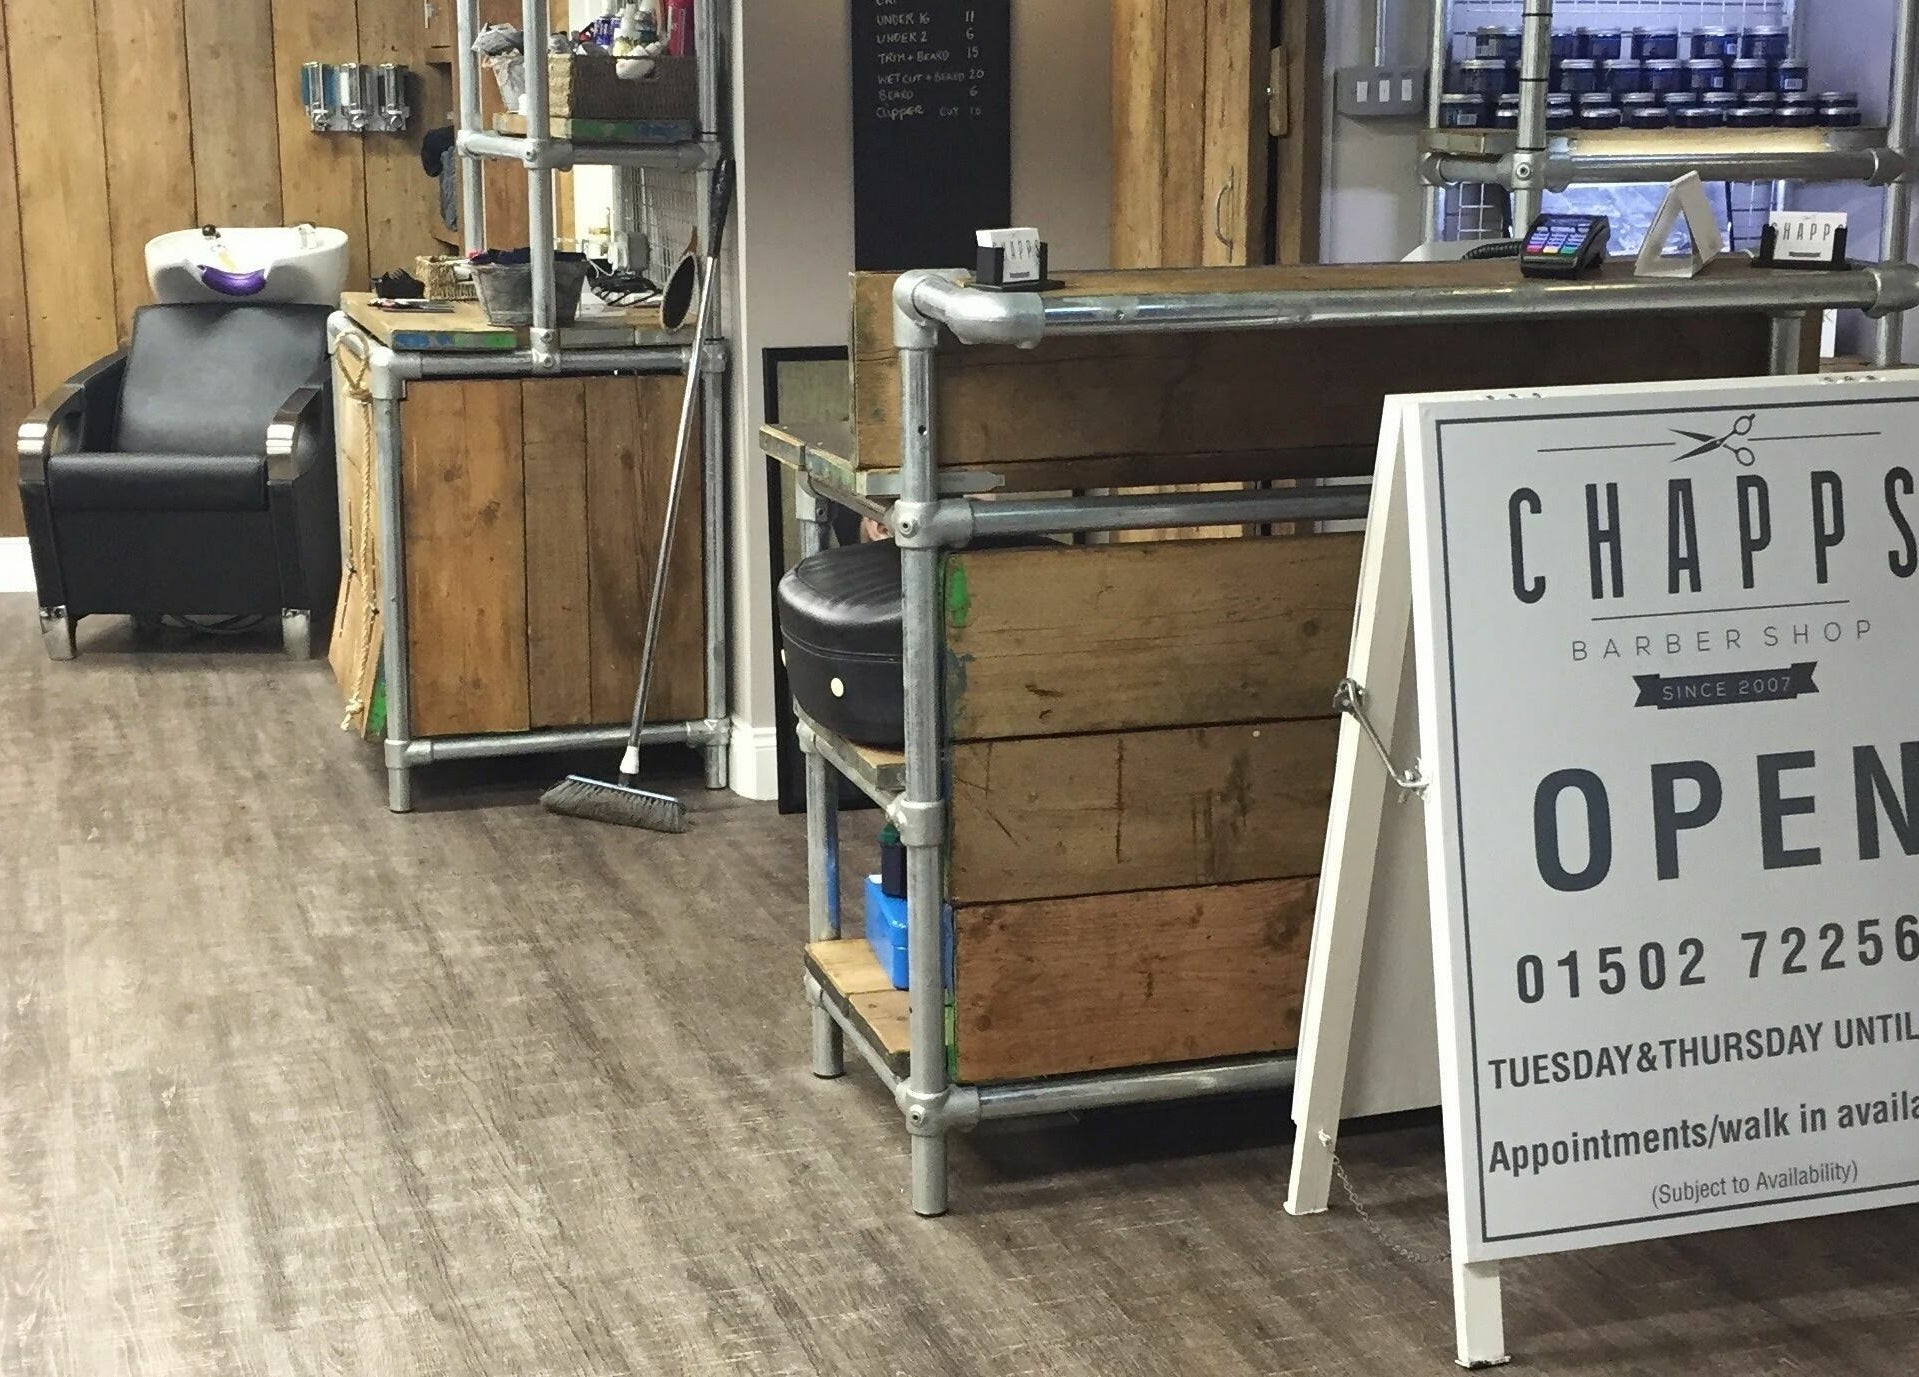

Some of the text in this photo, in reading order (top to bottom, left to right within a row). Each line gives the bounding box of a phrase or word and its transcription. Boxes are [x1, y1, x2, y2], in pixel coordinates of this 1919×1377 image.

[876, 12, 914, 26] UNDER
[876, 27, 975, 44] UNDER 2 6
[1508, 465, 1918, 603] CHAPPS
[1572, 619, 1871, 661] BARBER SHOP
[1662, 676, 1791, 701] SINCE 2007
[1533, 741, 1919, 892] OPEN
[1516, 914, 1919, 1004] 01502 72256
[1488, 1011, 1919, 1090] TUESDAY&THURSDAY UNTIL
[1800, 1103, 1827, 1134] in
[1652, 1159, 1858, 1209] (Subject to Availability)
